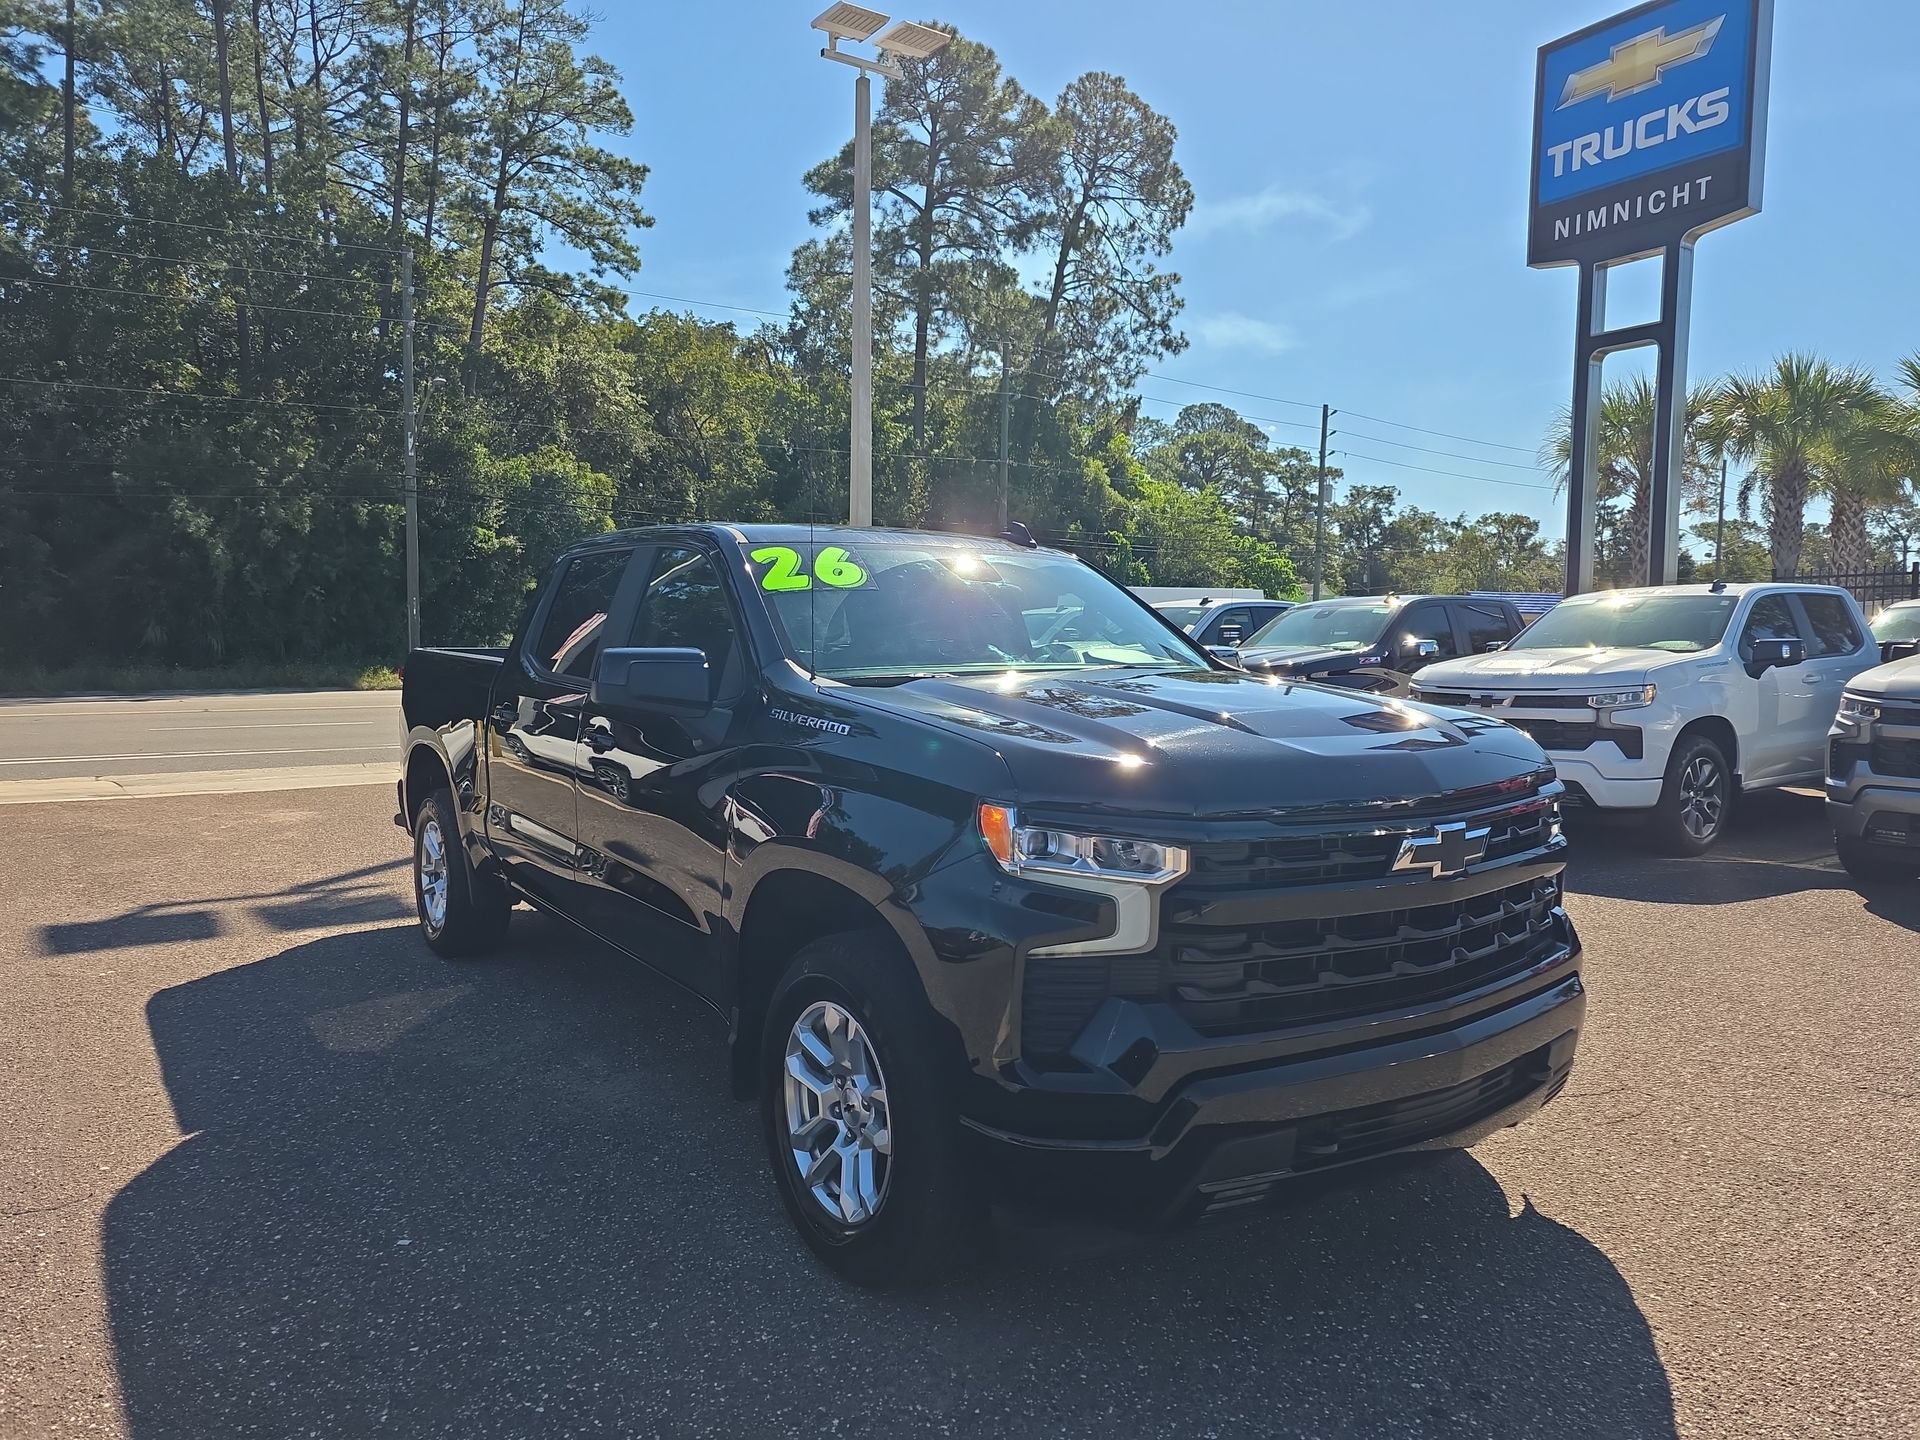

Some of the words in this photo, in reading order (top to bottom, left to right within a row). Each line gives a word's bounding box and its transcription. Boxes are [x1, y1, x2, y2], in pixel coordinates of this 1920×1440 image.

[1547, 86, 1730, 178] TRUCKS
[1554, 176, 1712, 241] NIMNICHT
[750, 545, 868, 592] 26
[769, 708, 851, 736] SILVERADO
